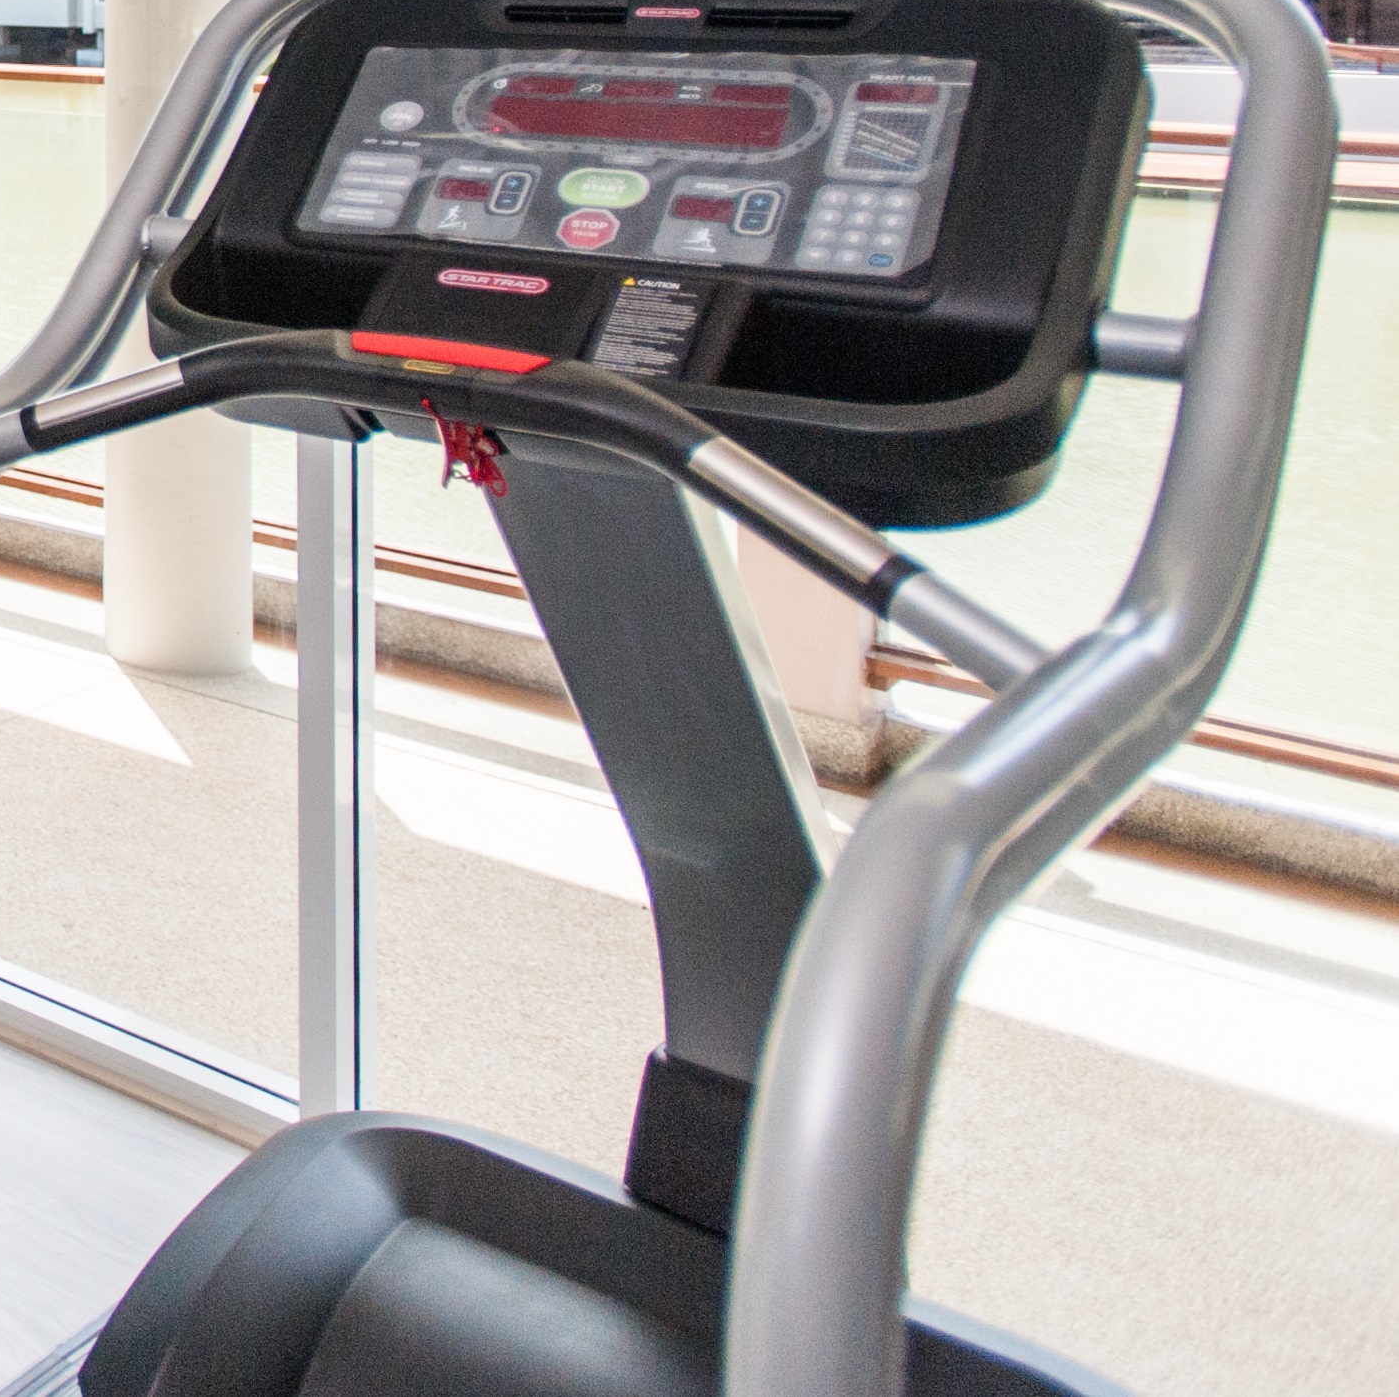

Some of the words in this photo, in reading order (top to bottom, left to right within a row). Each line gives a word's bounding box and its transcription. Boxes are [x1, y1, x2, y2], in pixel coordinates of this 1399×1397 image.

[694, 182, 729, 191] SPEED
[570, 219, 608, 230] STOP
[444, 273, 491, 285] STAR
[491, 277, 540, 290] TRAC
[637, 279, 681, 290] CAUTION
